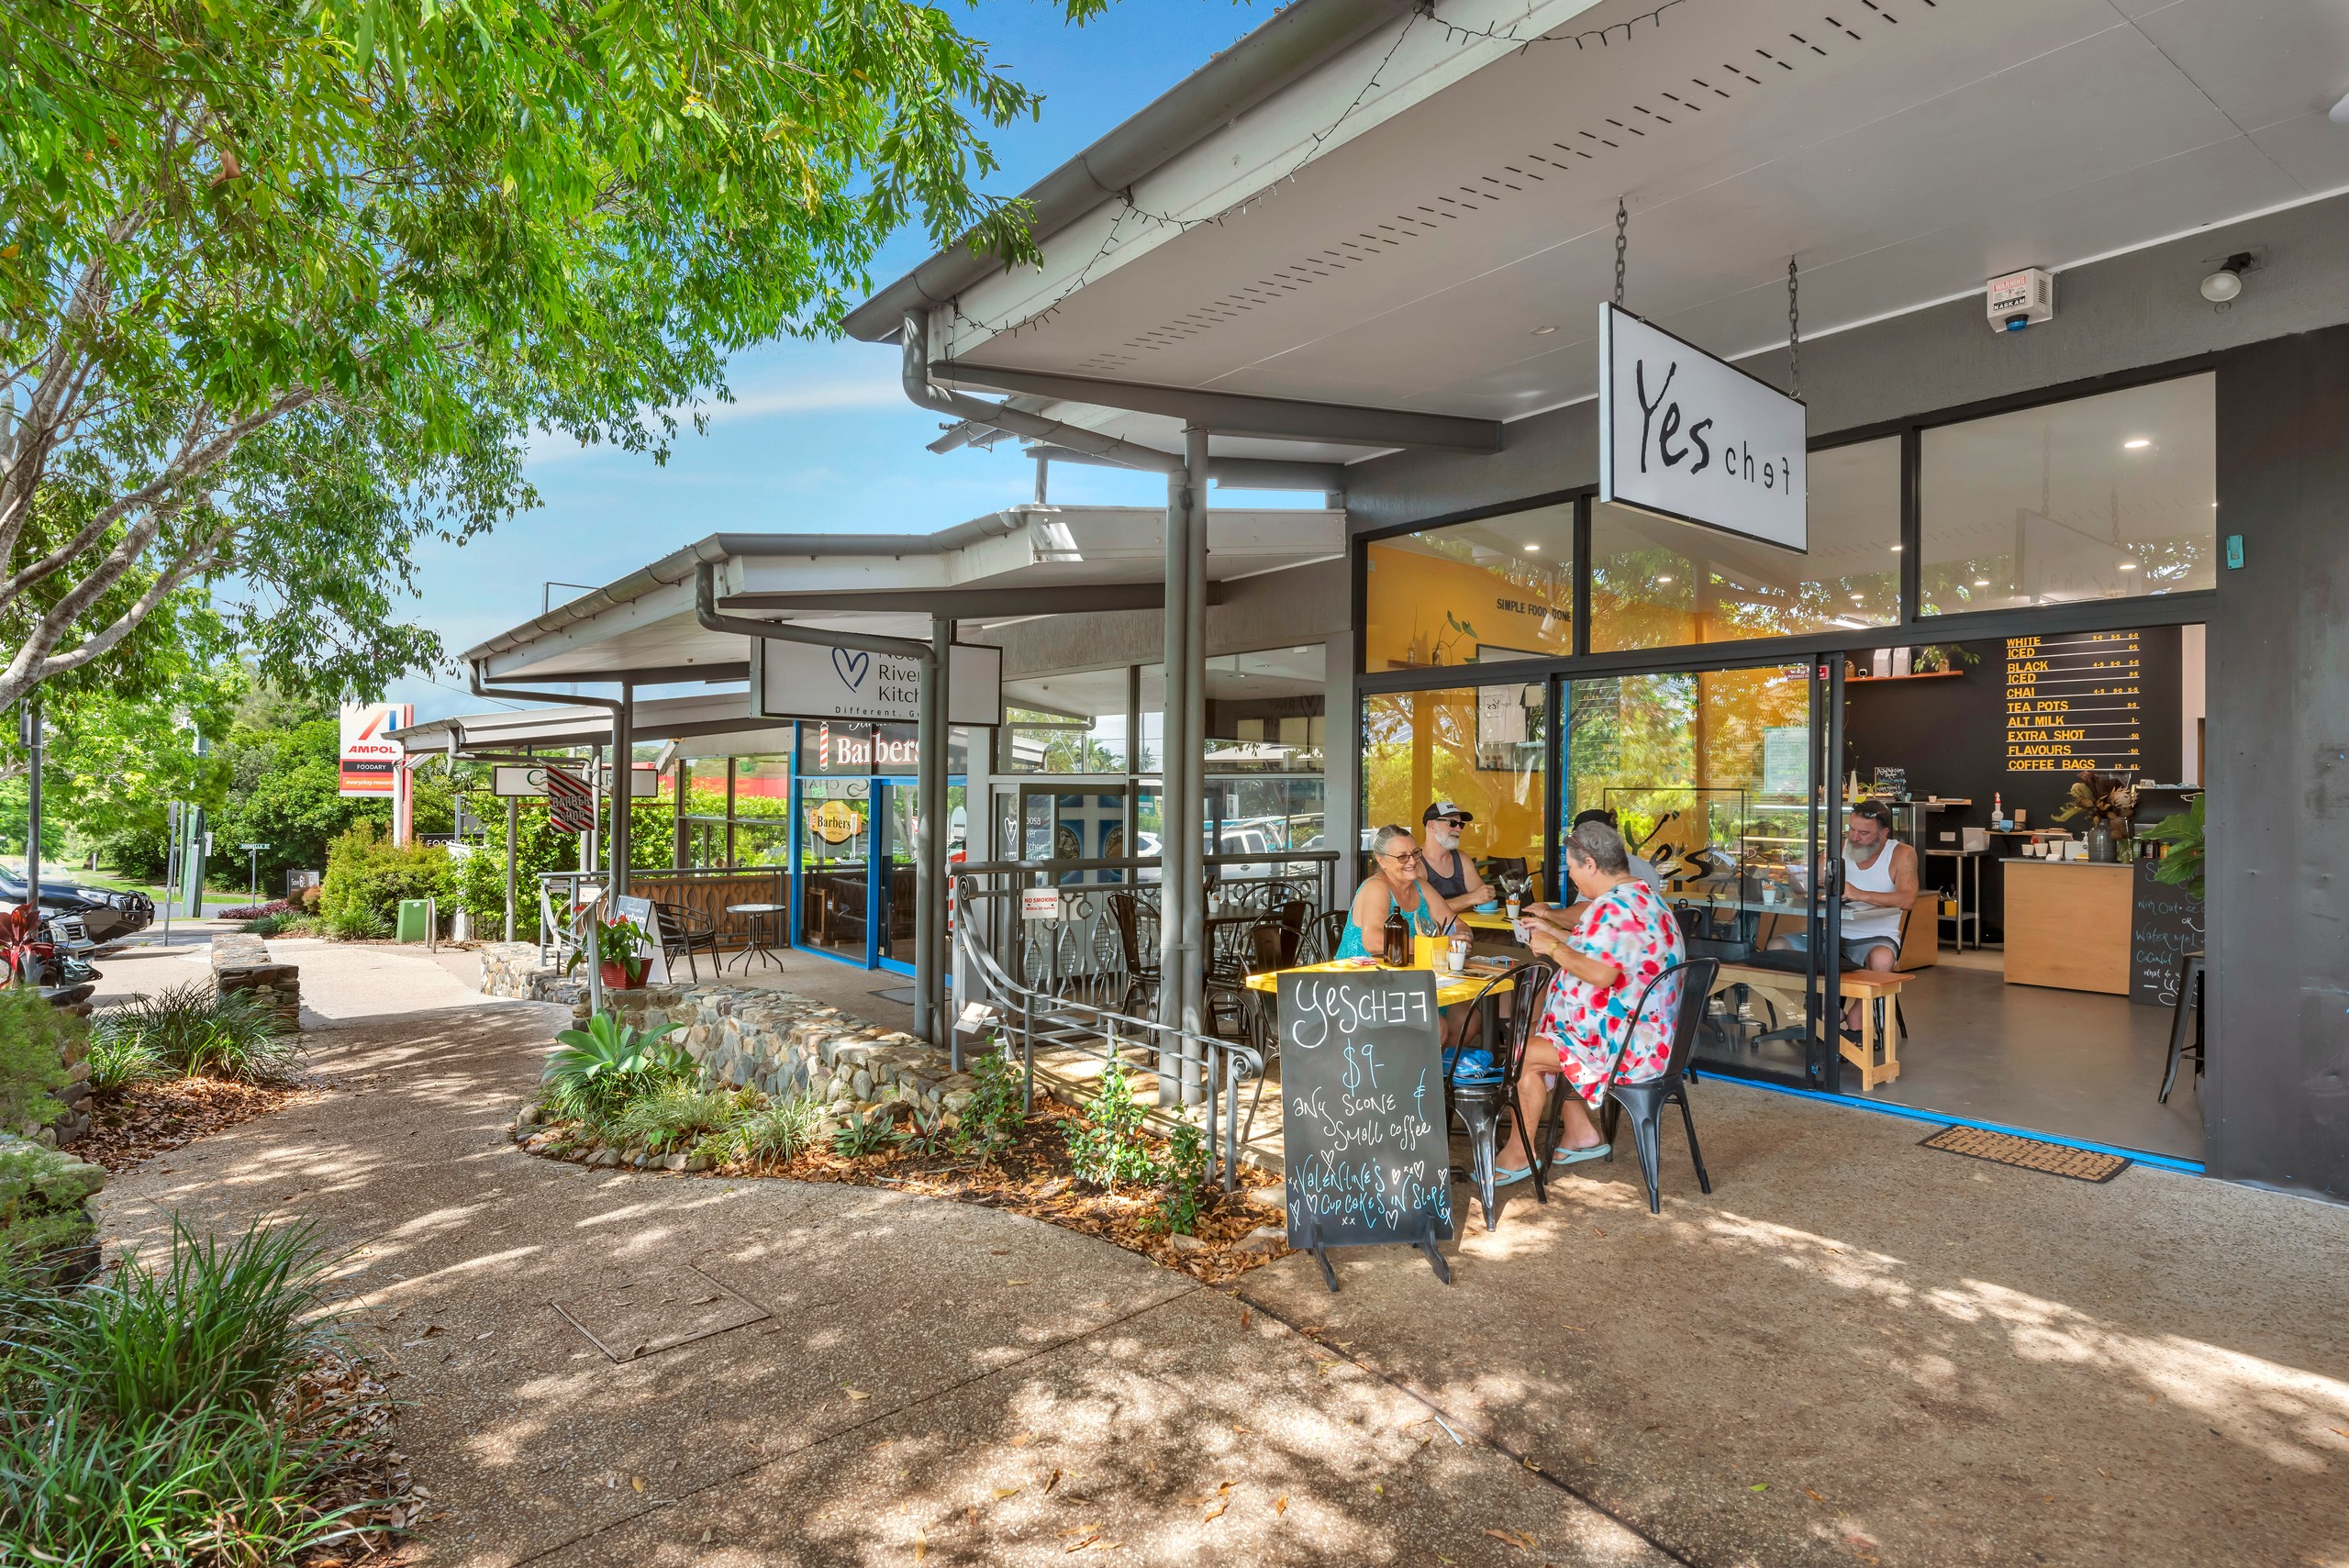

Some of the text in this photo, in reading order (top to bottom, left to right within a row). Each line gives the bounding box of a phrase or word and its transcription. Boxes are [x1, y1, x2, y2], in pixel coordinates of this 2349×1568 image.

[1994, 298, 2025, 310] NASKAM
[1637, 359, 1789, 495] Yes chef
[1497, 598, 1572, 623] SIMPLE FOOD DONE
[2007, 637, 2041, 647] WHITE
[2008, 648, 2035, 659] ICED
[2007, 661, 2048, 673] BLACK
[2008, 673, 2036, 684] ICED
[879, 686, 919, 703] Kitch
[2007, 687, 2035, 698] CHAI
[2007, 702, 2031, 713] TEA
[2037, 701, 2069, 712] POTS
[2008, 717, 2030, 727] ALT
[2034, 716, 2065, 726] MILK
[2008, 731, 2047, 741] EXTRA
[2054, 730, 2085, 740] SHOT
[2008, 745, 2072, 755] FLAVOURS
[2008, 760, 2054, 770] COFFEE
[2062, 760, 2096, 770] BAGS
[552, 795, 592, 807] BARBER
[561, 811, 585, 822] SHOP
[1026, 817, 1041, 825] oosa
[818, 816, 852, 829] Barbers
[1026, 829, 1037, 838] ver
[1026, 840, 1044, 852] tchen
